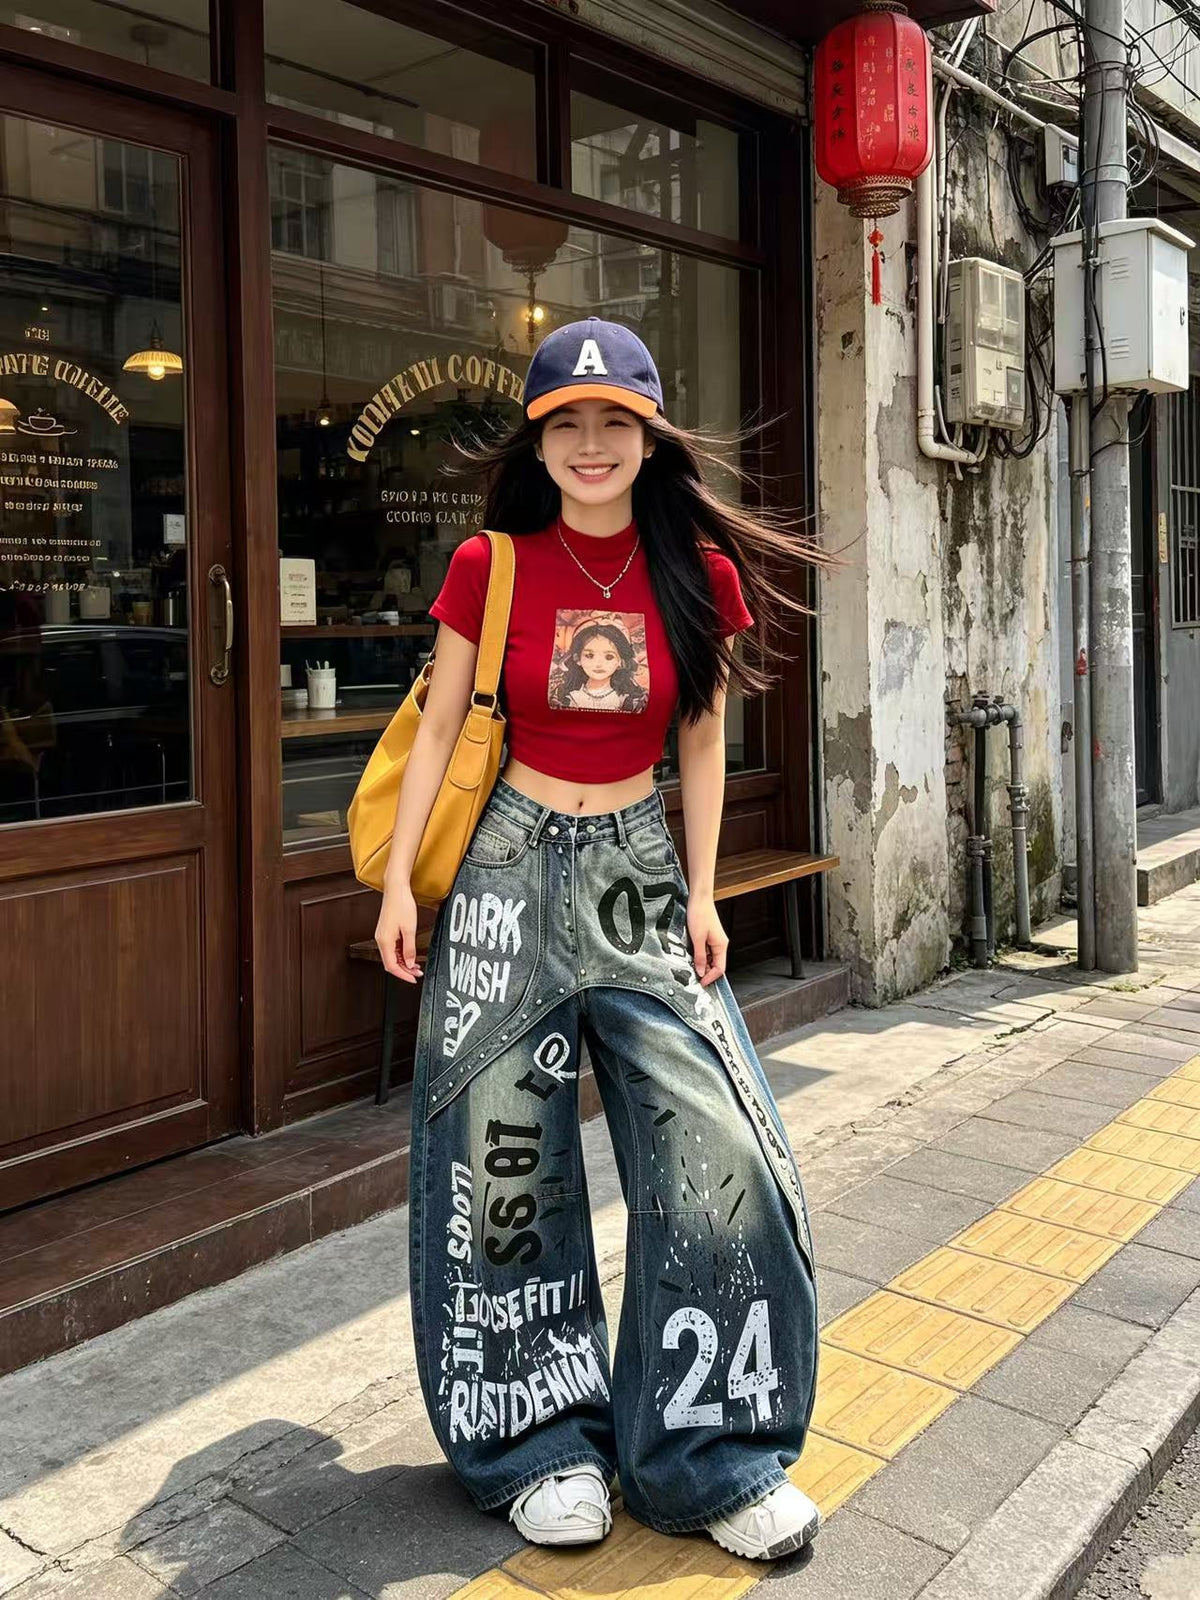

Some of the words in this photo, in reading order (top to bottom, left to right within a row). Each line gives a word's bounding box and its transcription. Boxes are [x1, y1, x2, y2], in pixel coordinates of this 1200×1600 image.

[572, 339, 608, 377] A
[449, 892, 527, 956] DARK
[449, 946, 511, 1004] WASH
[662, 1299, 779, 1430] 24
